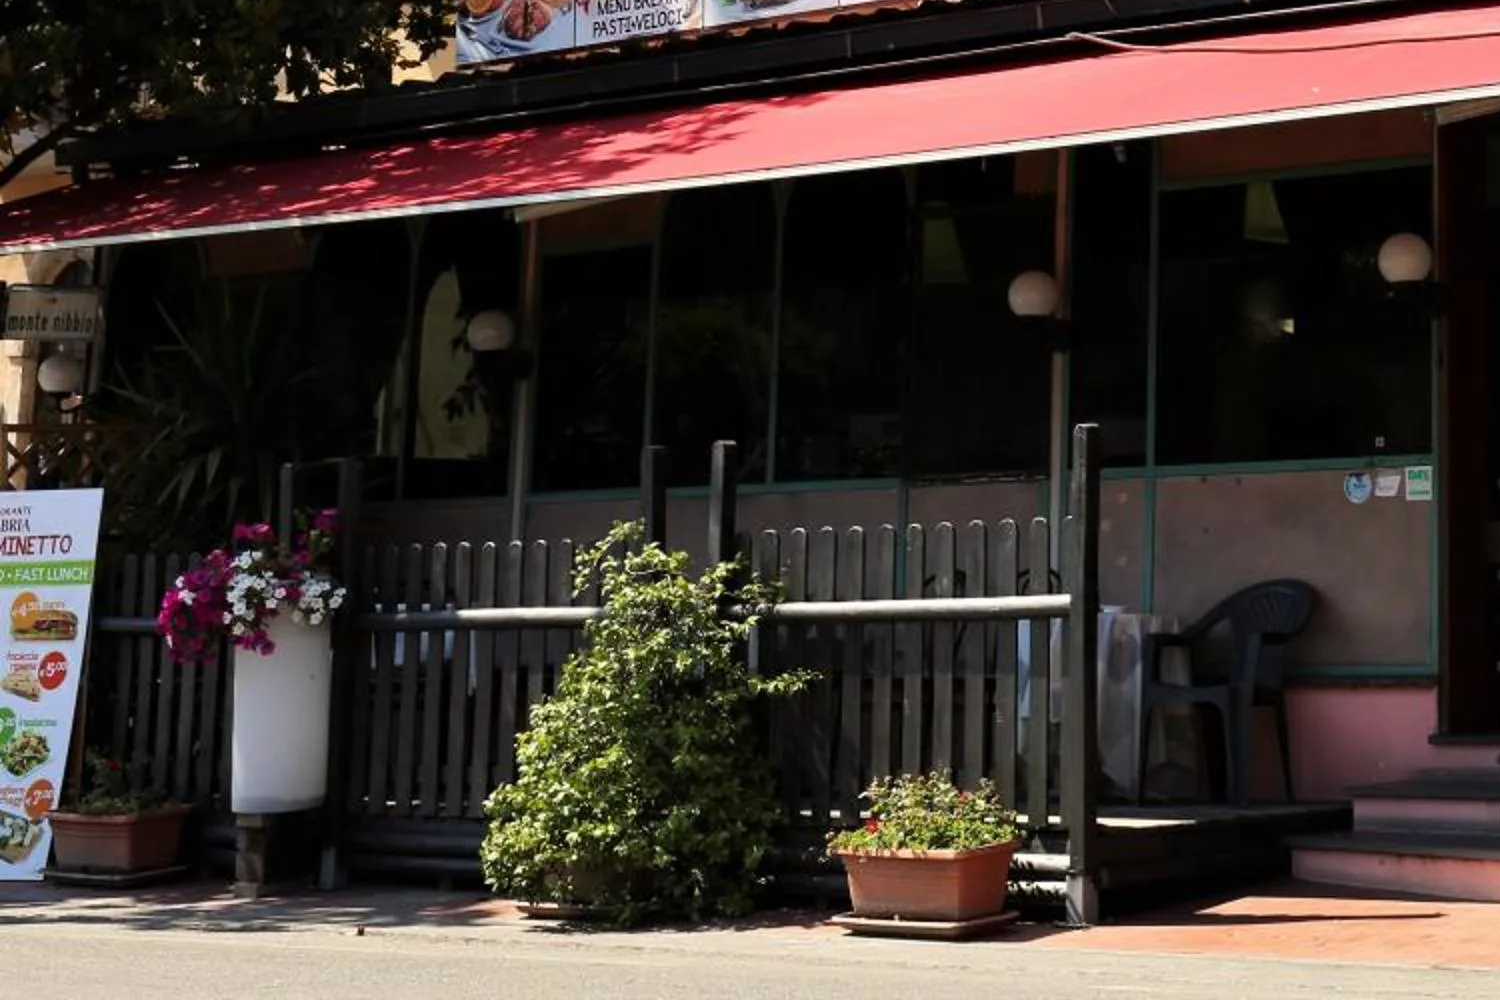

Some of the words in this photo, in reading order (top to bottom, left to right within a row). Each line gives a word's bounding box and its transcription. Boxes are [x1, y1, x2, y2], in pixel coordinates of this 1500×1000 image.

[634, 7, 682, 31] VELOCI
[8, 311, 48, 331] monte
[16, 567, 45, 581] FAST
[47, 567, 89, 581] LUNCH
